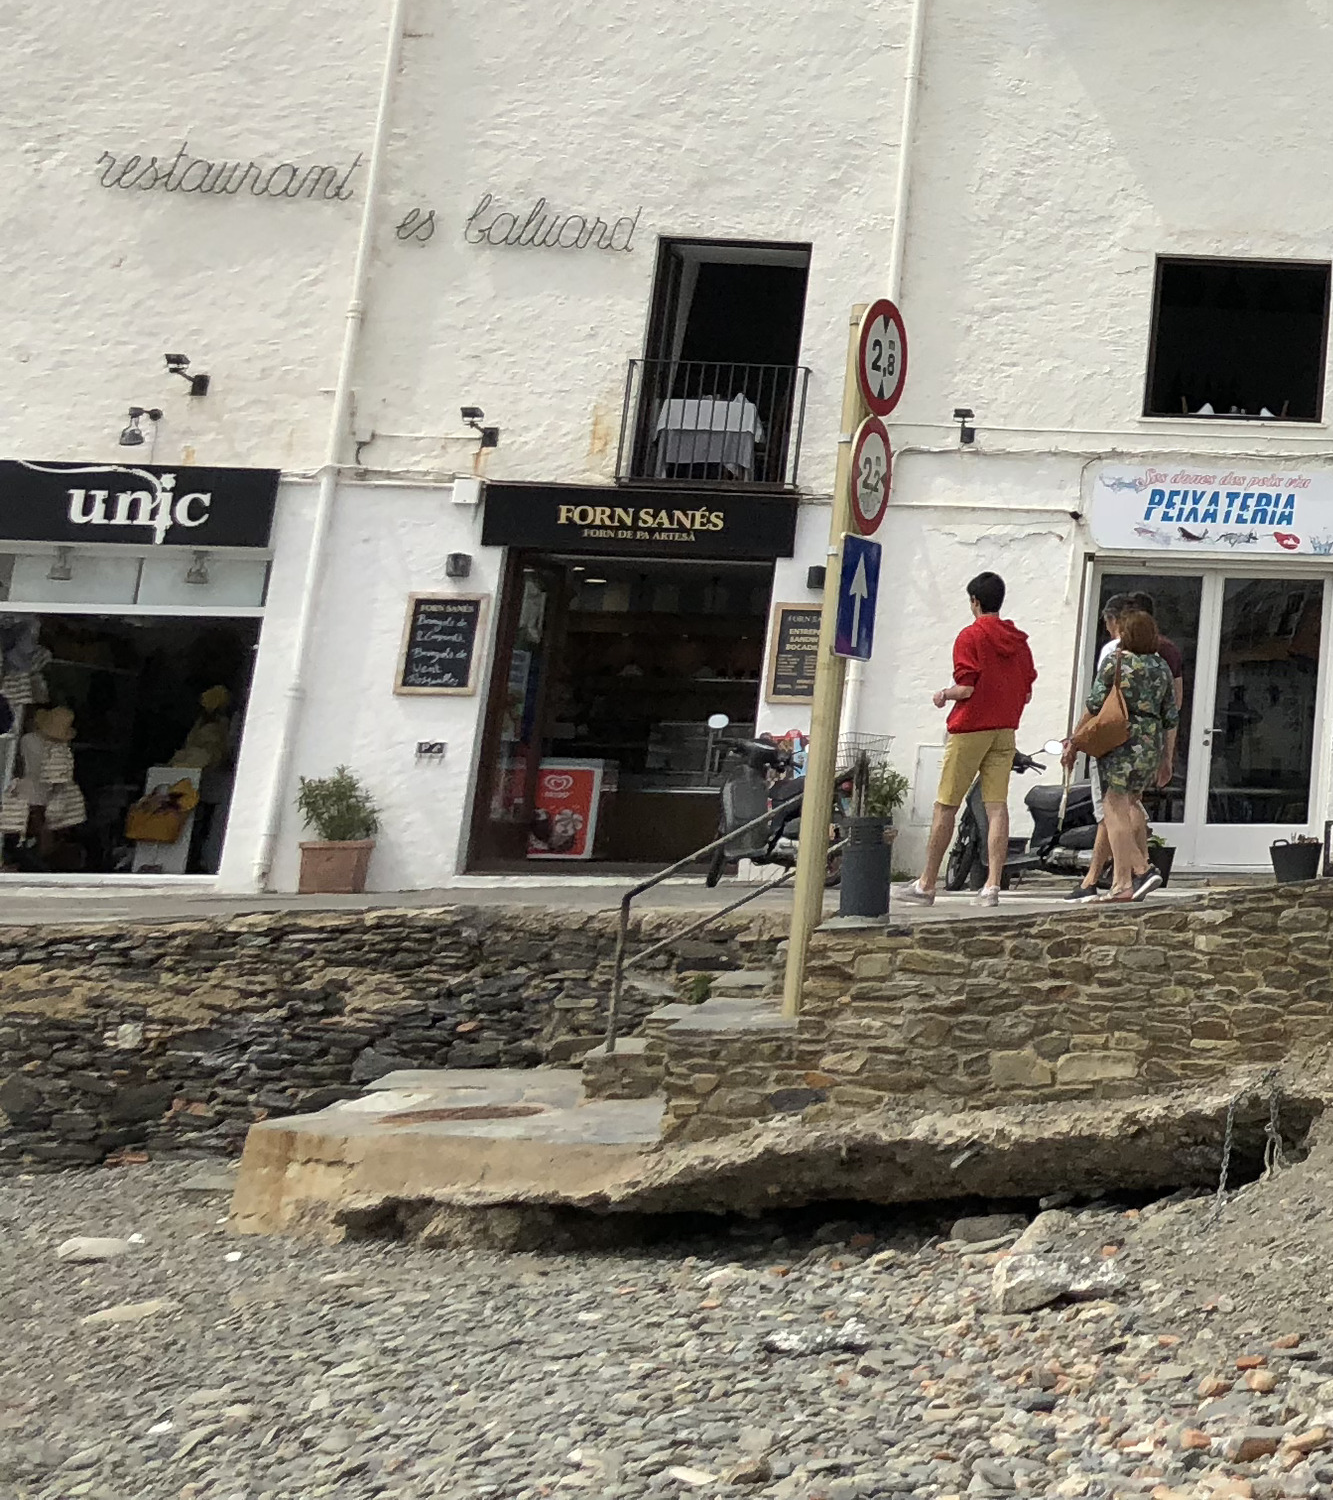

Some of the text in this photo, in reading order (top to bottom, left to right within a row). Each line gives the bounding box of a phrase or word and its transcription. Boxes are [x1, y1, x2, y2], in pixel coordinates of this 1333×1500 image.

[96, 141, 364, 201] restaurant
[395, 193, 643, 252] es baluard
[557, 504, 725, 531] FORN SANÉS
[1143, 488, 1297, 526] PEIXATERIA
[582, 528, 616, 539] FORN
[617, 529, 634, 540] DE
[635, 530, 650, 541] PA
